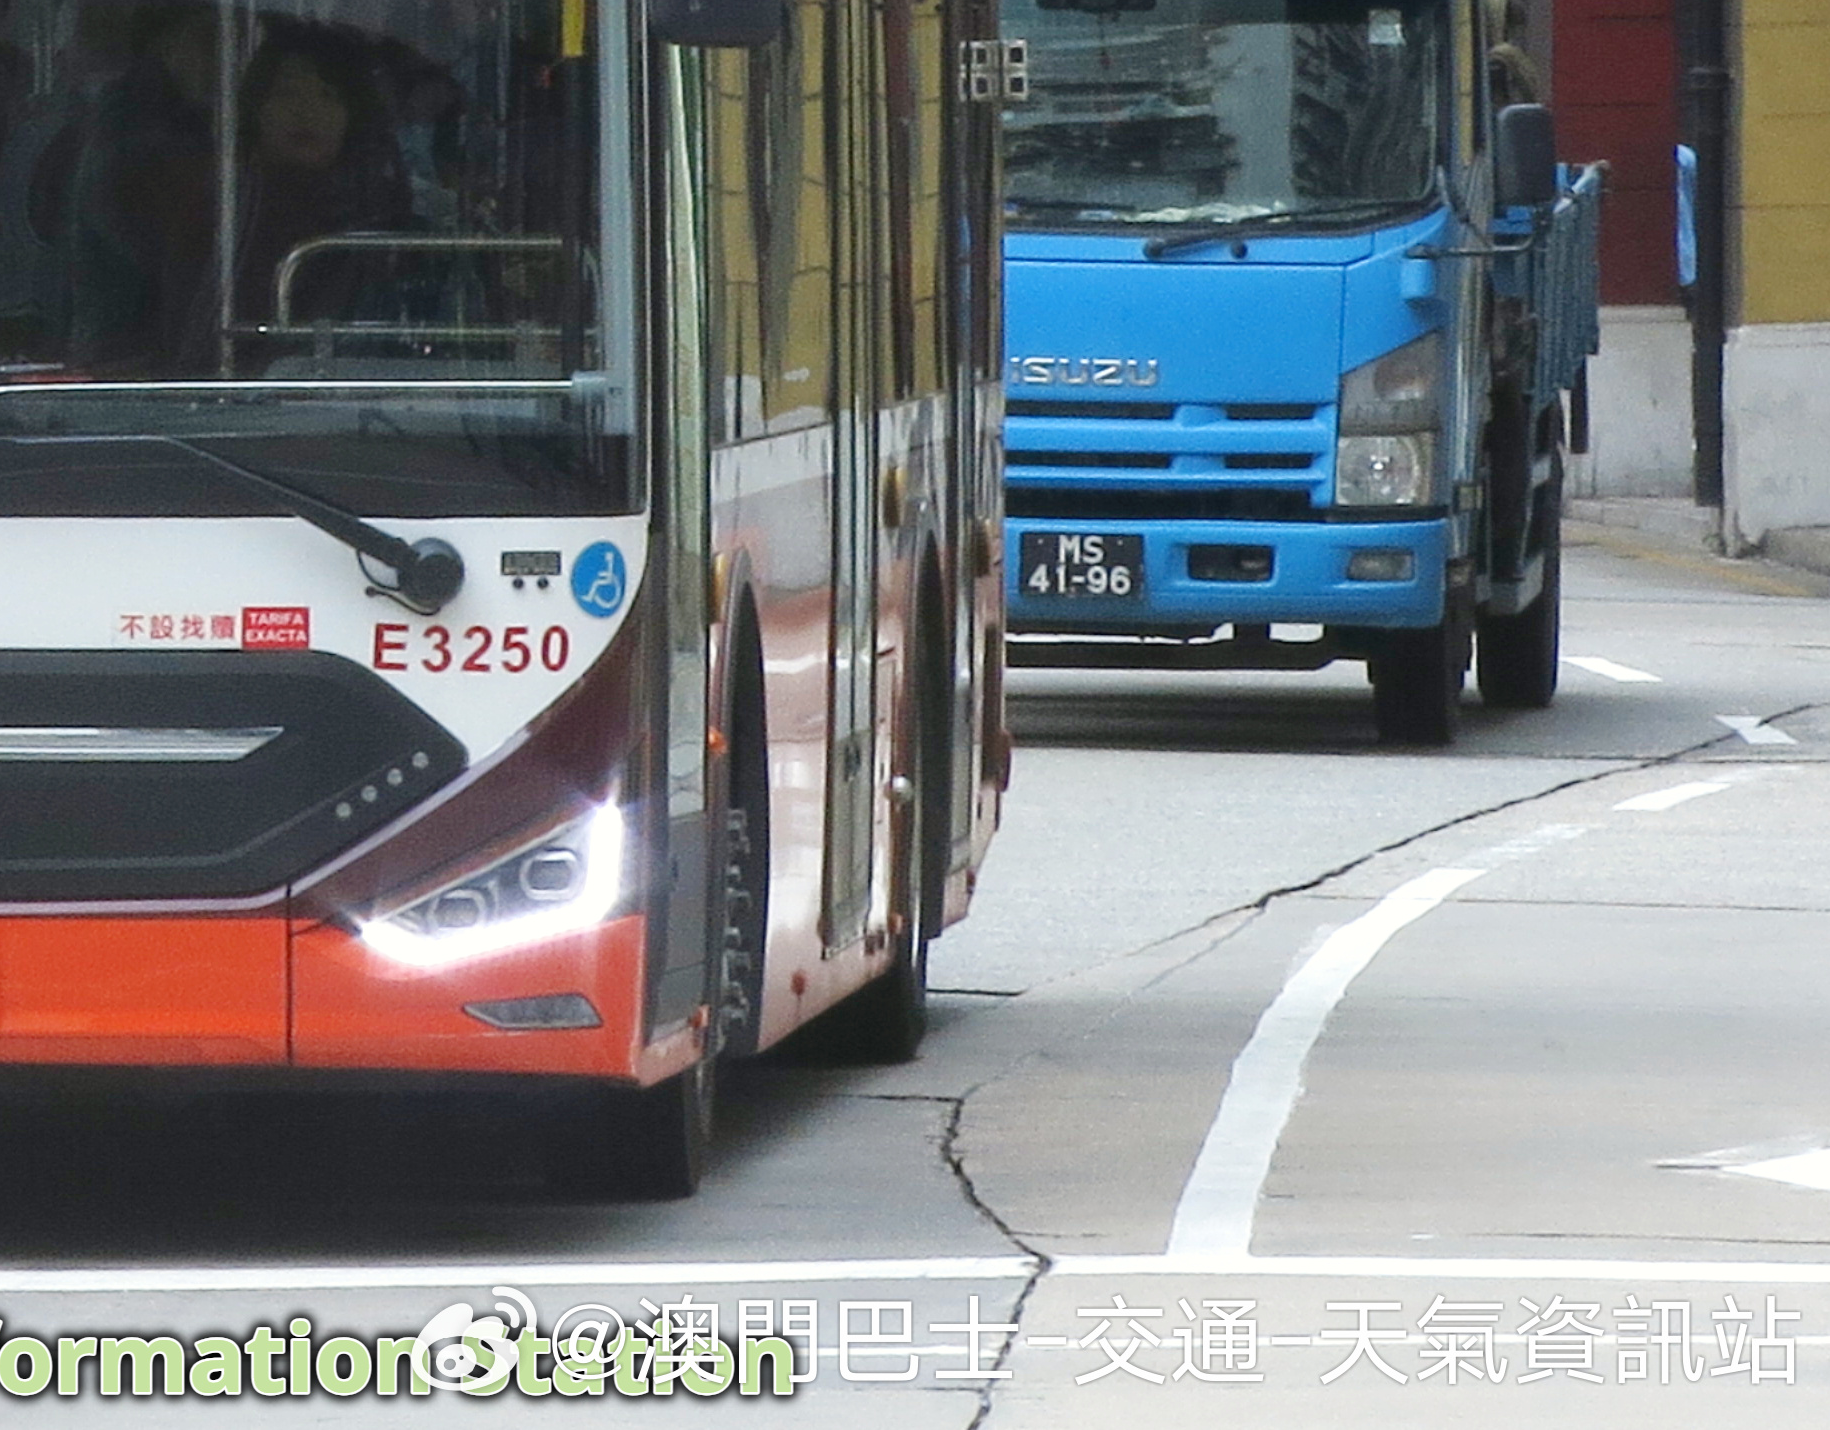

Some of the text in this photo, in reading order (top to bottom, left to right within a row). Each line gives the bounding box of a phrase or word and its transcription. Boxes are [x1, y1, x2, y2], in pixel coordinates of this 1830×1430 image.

[1008, 356, 1159, 387] ISUZU
[1058, 535, 1105, 565] MS
[1028, 563, 1132, 595] 41-96
[249, 612, 305, 626] TARIFA
[245, 628, 307, 643] EXACTA
[373, 623, 570, 673] E3250
